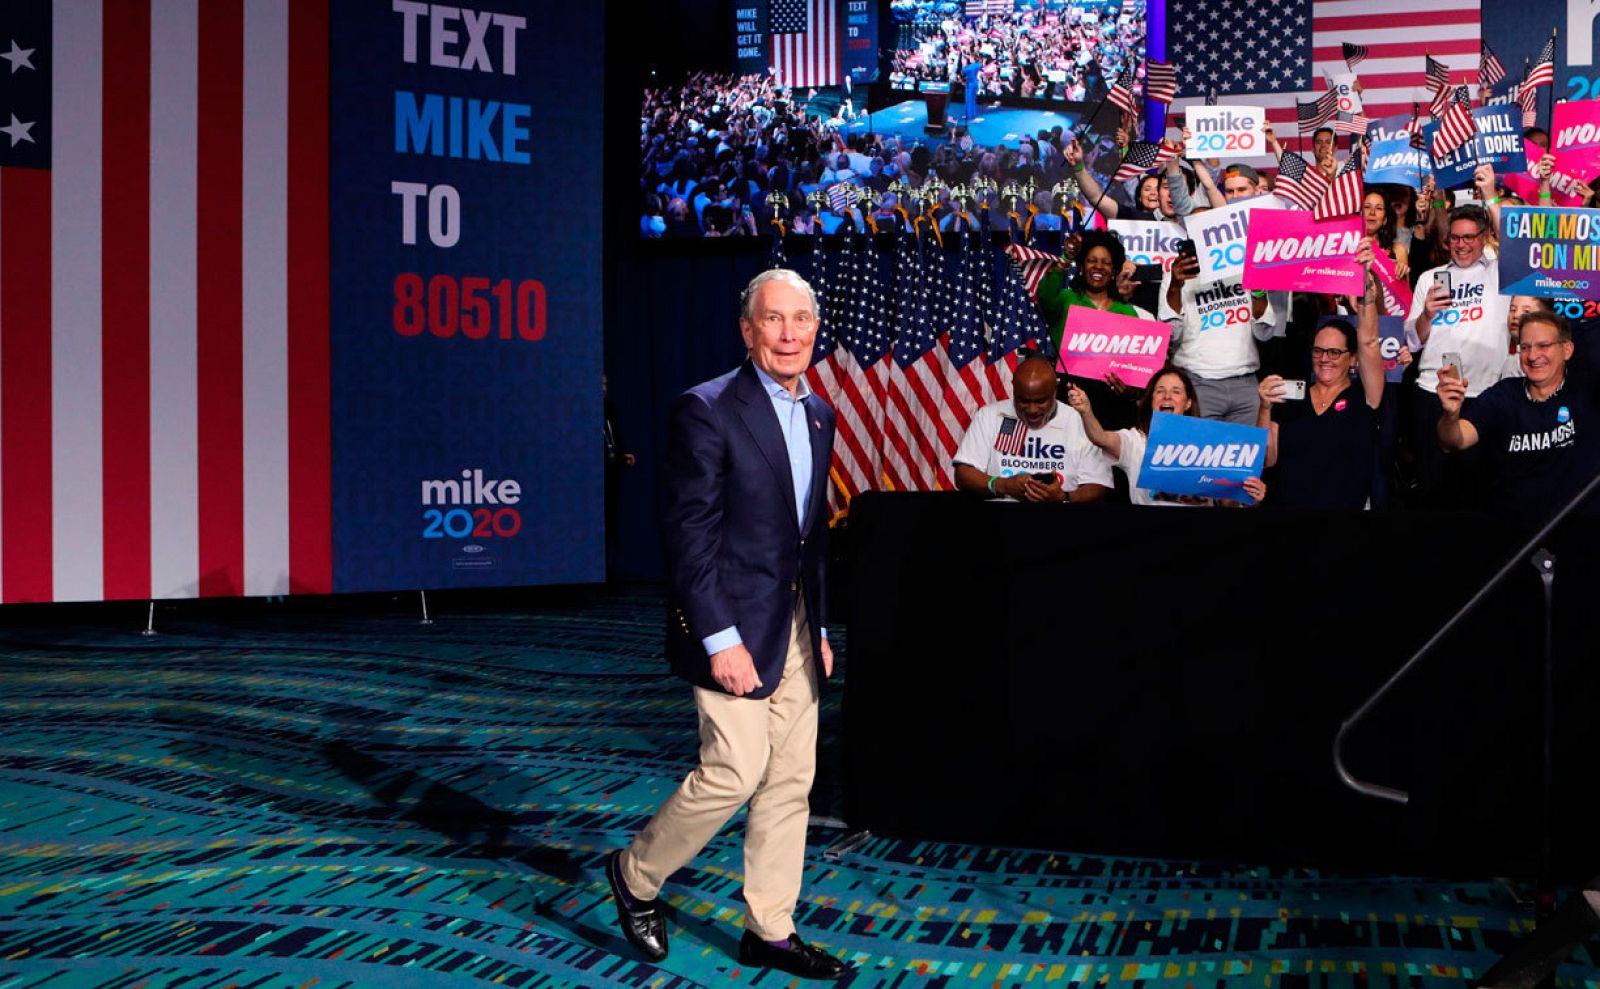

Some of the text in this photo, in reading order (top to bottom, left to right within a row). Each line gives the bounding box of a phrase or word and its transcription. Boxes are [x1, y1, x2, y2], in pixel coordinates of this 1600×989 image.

[736, 9, 757, 19] MIKE
[848, 1, 868, 12] TEXT
[737, 22, 757, 32] WILL
[848, 26, 859, 38] TO
[392, 0, 527, 76] TEXT
[737, 34, 762, 45] GET IT
[738, 47, 761, 58] DONE.
[395, 90, 532, 165] MIKE
[1196, 111, 1255, 132] mike
[1475, 114, 1513, 134] WILL
[1197, 132, 1255, 151] 2020
[1484, 134, 1524, 154] DONE.
[391, 180, 461, 248] TO
[1252, 230, 1361, 263] WOMEN
[1529, 242, 1567, 269] CON
[1195, 278, 1246, 306] mike
[1535, 277, 1590, 289] mike2020
[392, 272, 547, 341] 80510
[1431, 306, 1483, 326] 2020
[1200, 306, 1251, 332] 2020
[1067, 332, 1163, 355] WOMEN
[1002, 437, 1066, 459] ike
[1151, 443, 1260, 468] WOMEN
[1001, 458, 1065, 470] BLOOMBERG
[421, 468, 521, 505] mike
[1198, 474, 1213, 483] for
[423, 507, 522, 538] 2020
